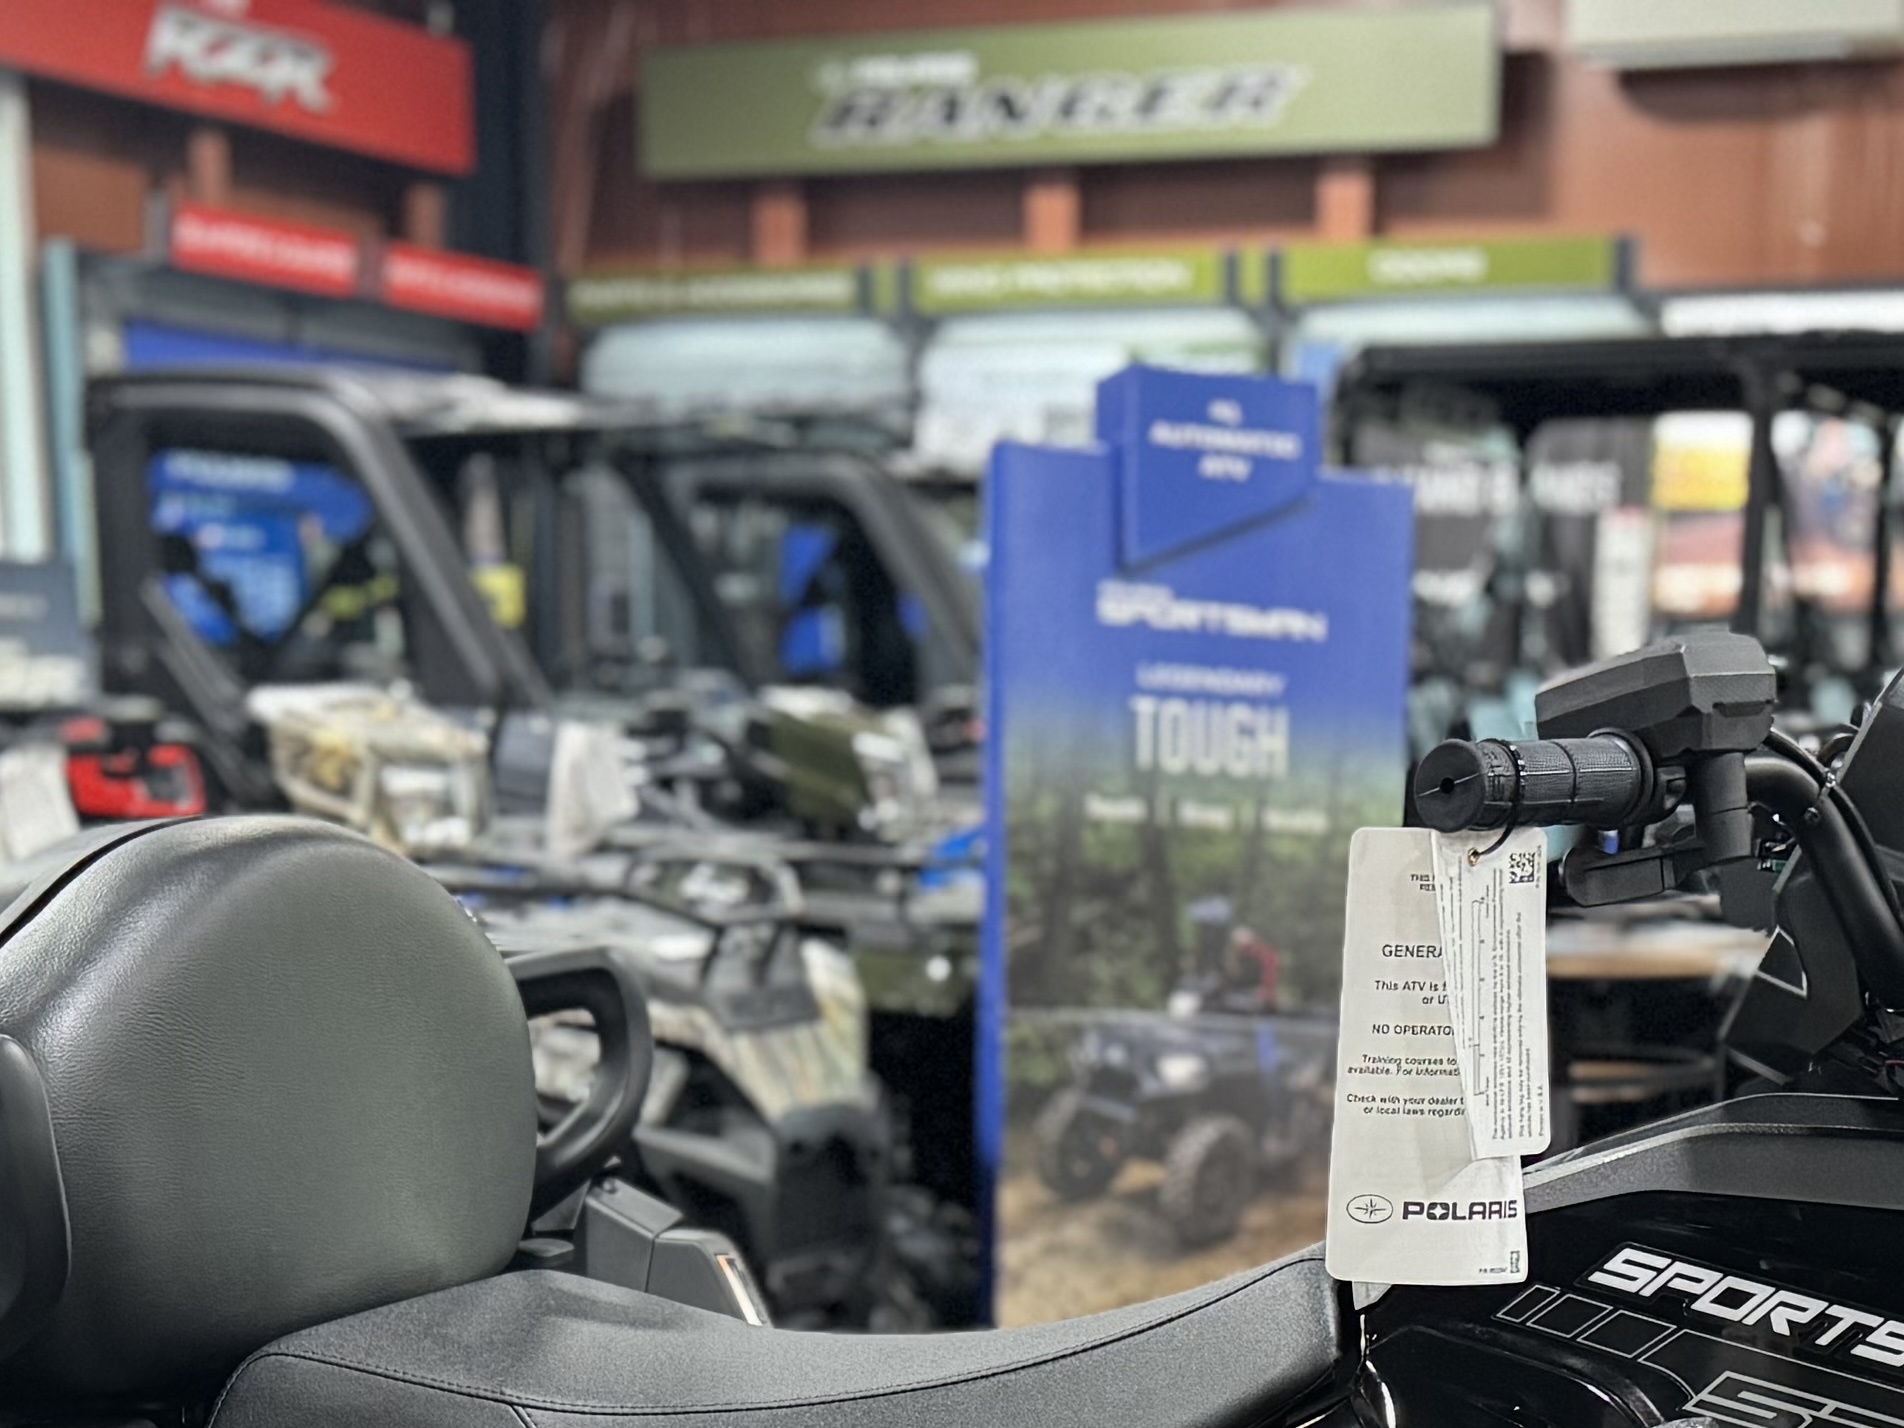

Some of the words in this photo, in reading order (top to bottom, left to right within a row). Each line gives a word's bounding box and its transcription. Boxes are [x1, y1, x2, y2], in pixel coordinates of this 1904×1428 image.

[812, 64, 1308, 148] RANGER
[1097, 597, 1328, 642] SPORTSMAN
[1131, 695, 1290, 778] TOUGH
[1375, 980, 1399, 991] This
[1402, 981, 1426, 992] ATV
[1372, 1024, 1390, 1035] NO
[1394, 1024, 1455, 1036] OPERATO
[1402, 1200, 1518, 1221] POLARIS
